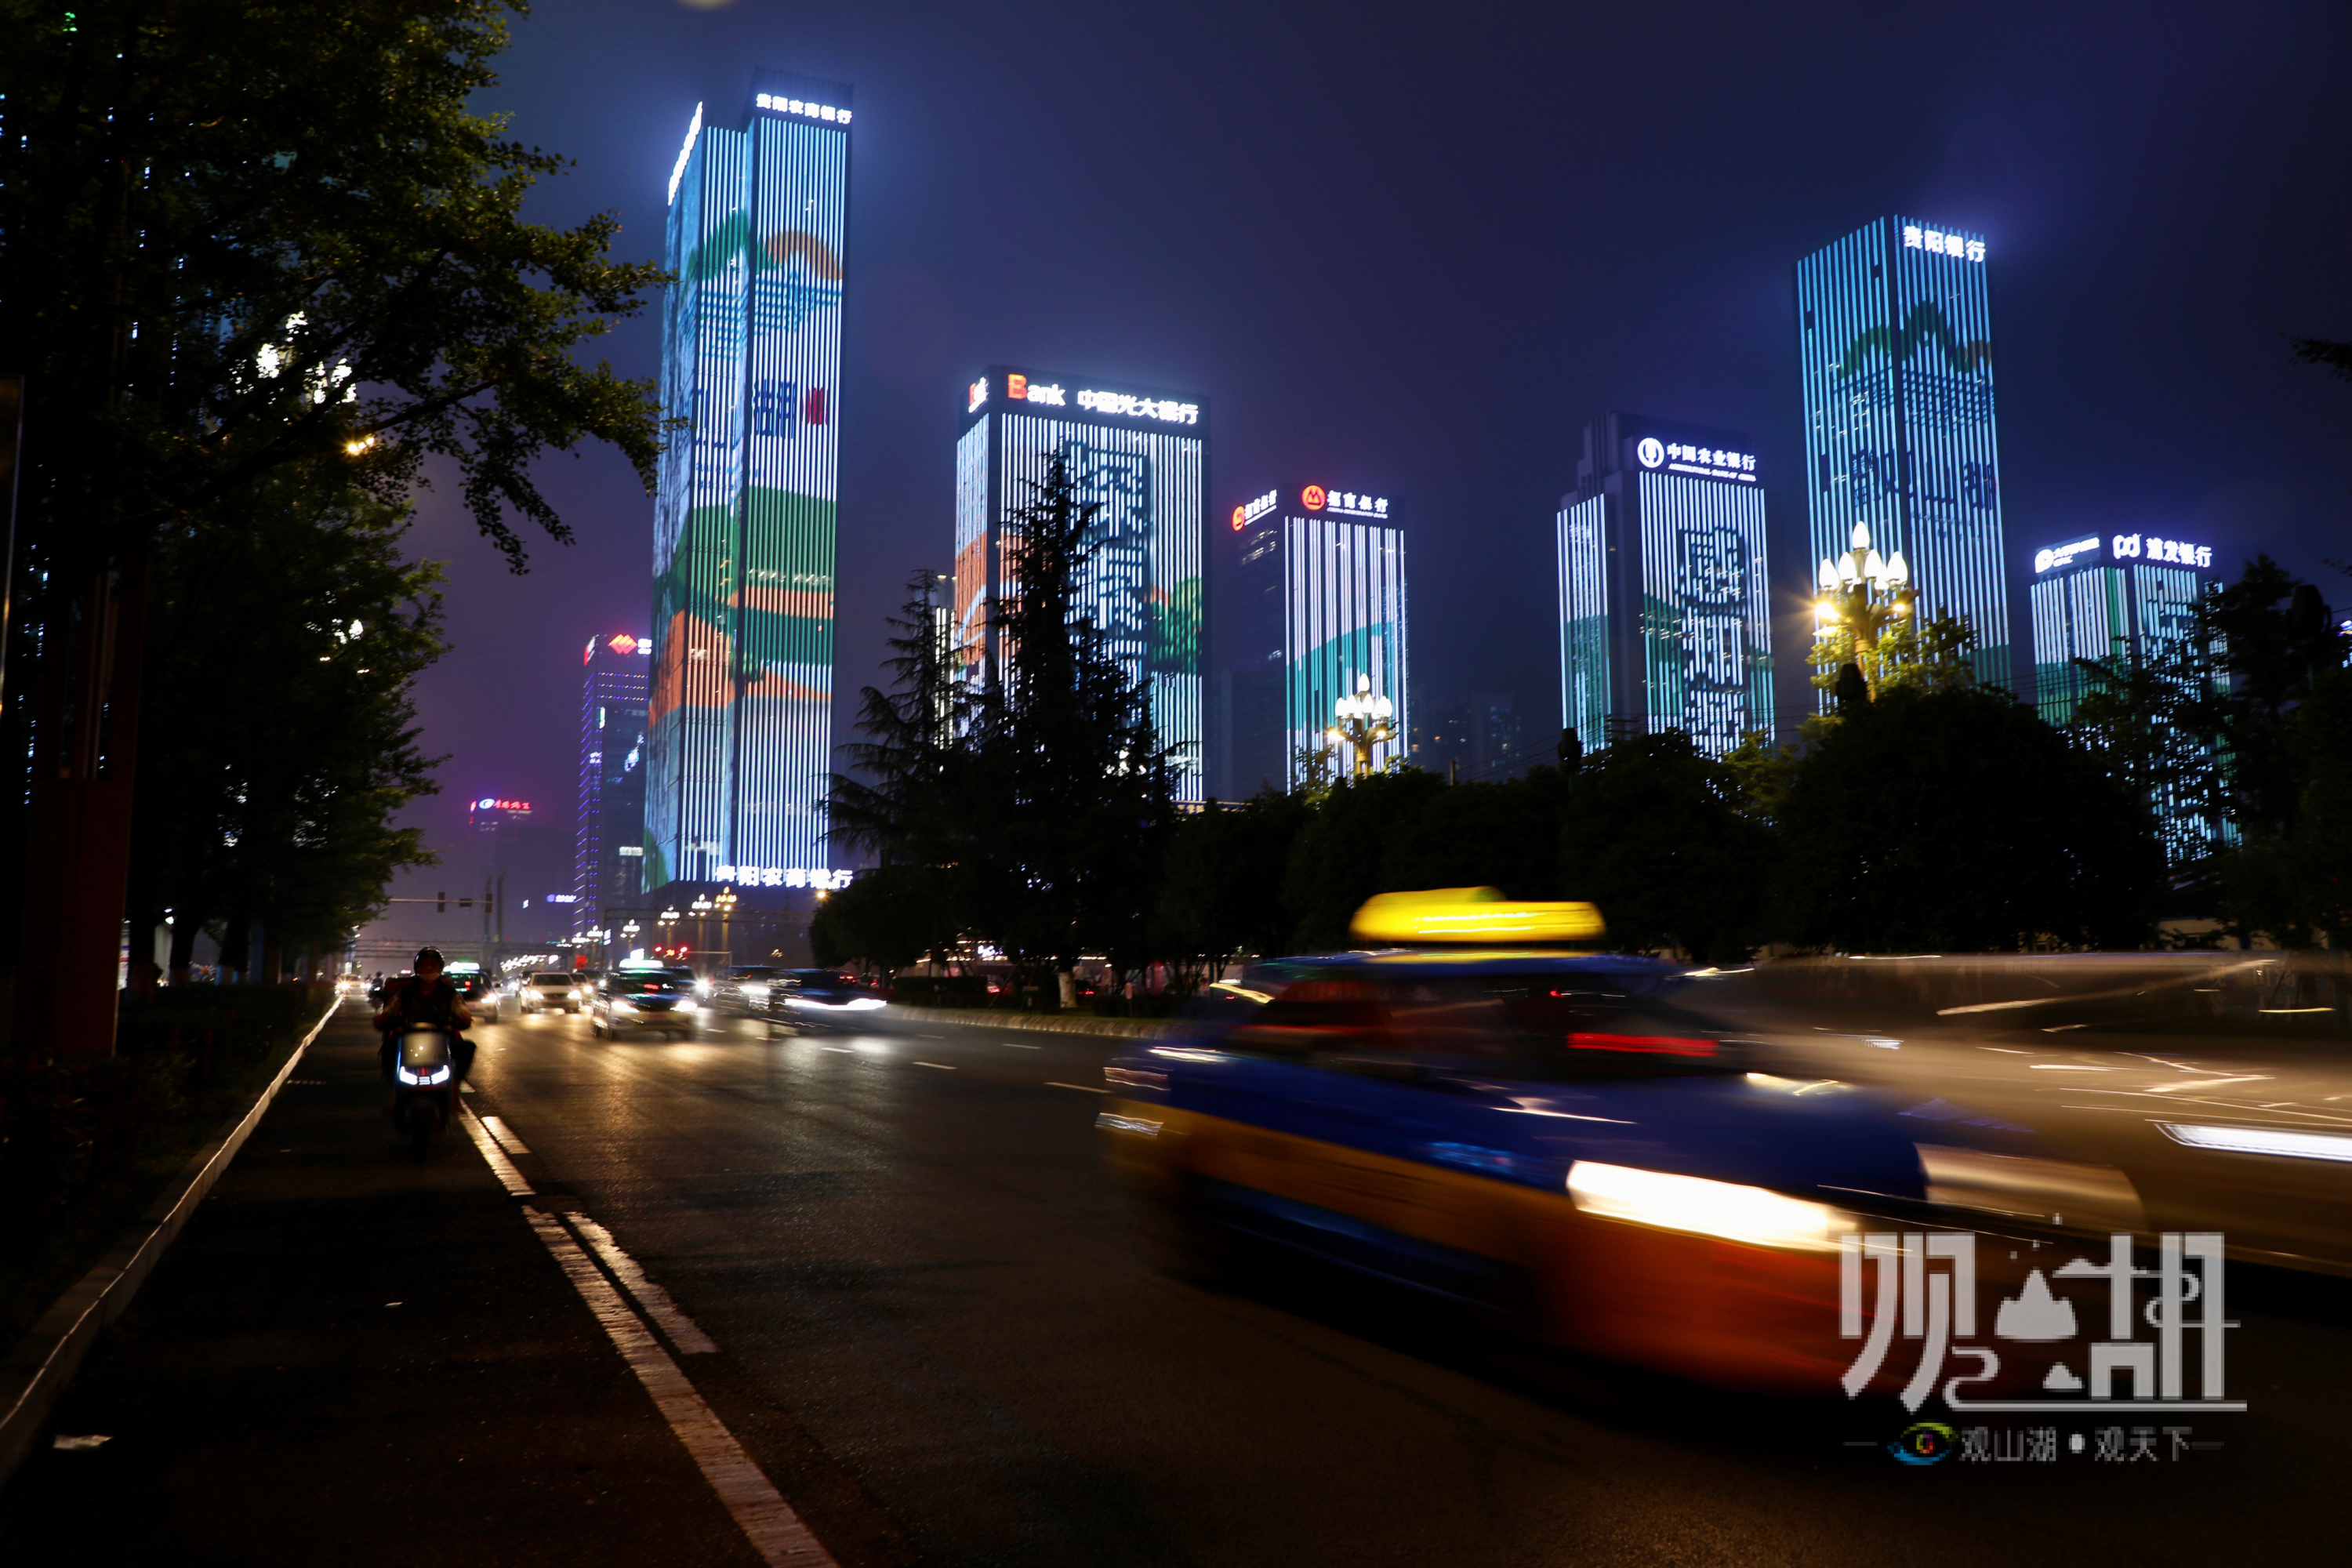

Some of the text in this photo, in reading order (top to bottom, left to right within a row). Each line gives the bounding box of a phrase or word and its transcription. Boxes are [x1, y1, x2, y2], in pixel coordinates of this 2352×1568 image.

[1903, 225, 1986, 263] 贵阳银行
[1007, 373, 1066, 406] Bank
[1077, 389, 1199, 425] 中国光大银行
[1667, 442, 1756, 471] 中国农业银行
[1327, 490, 1388, 514] 招商银行
[2146, 536, 2212, 568] 浦发银行
